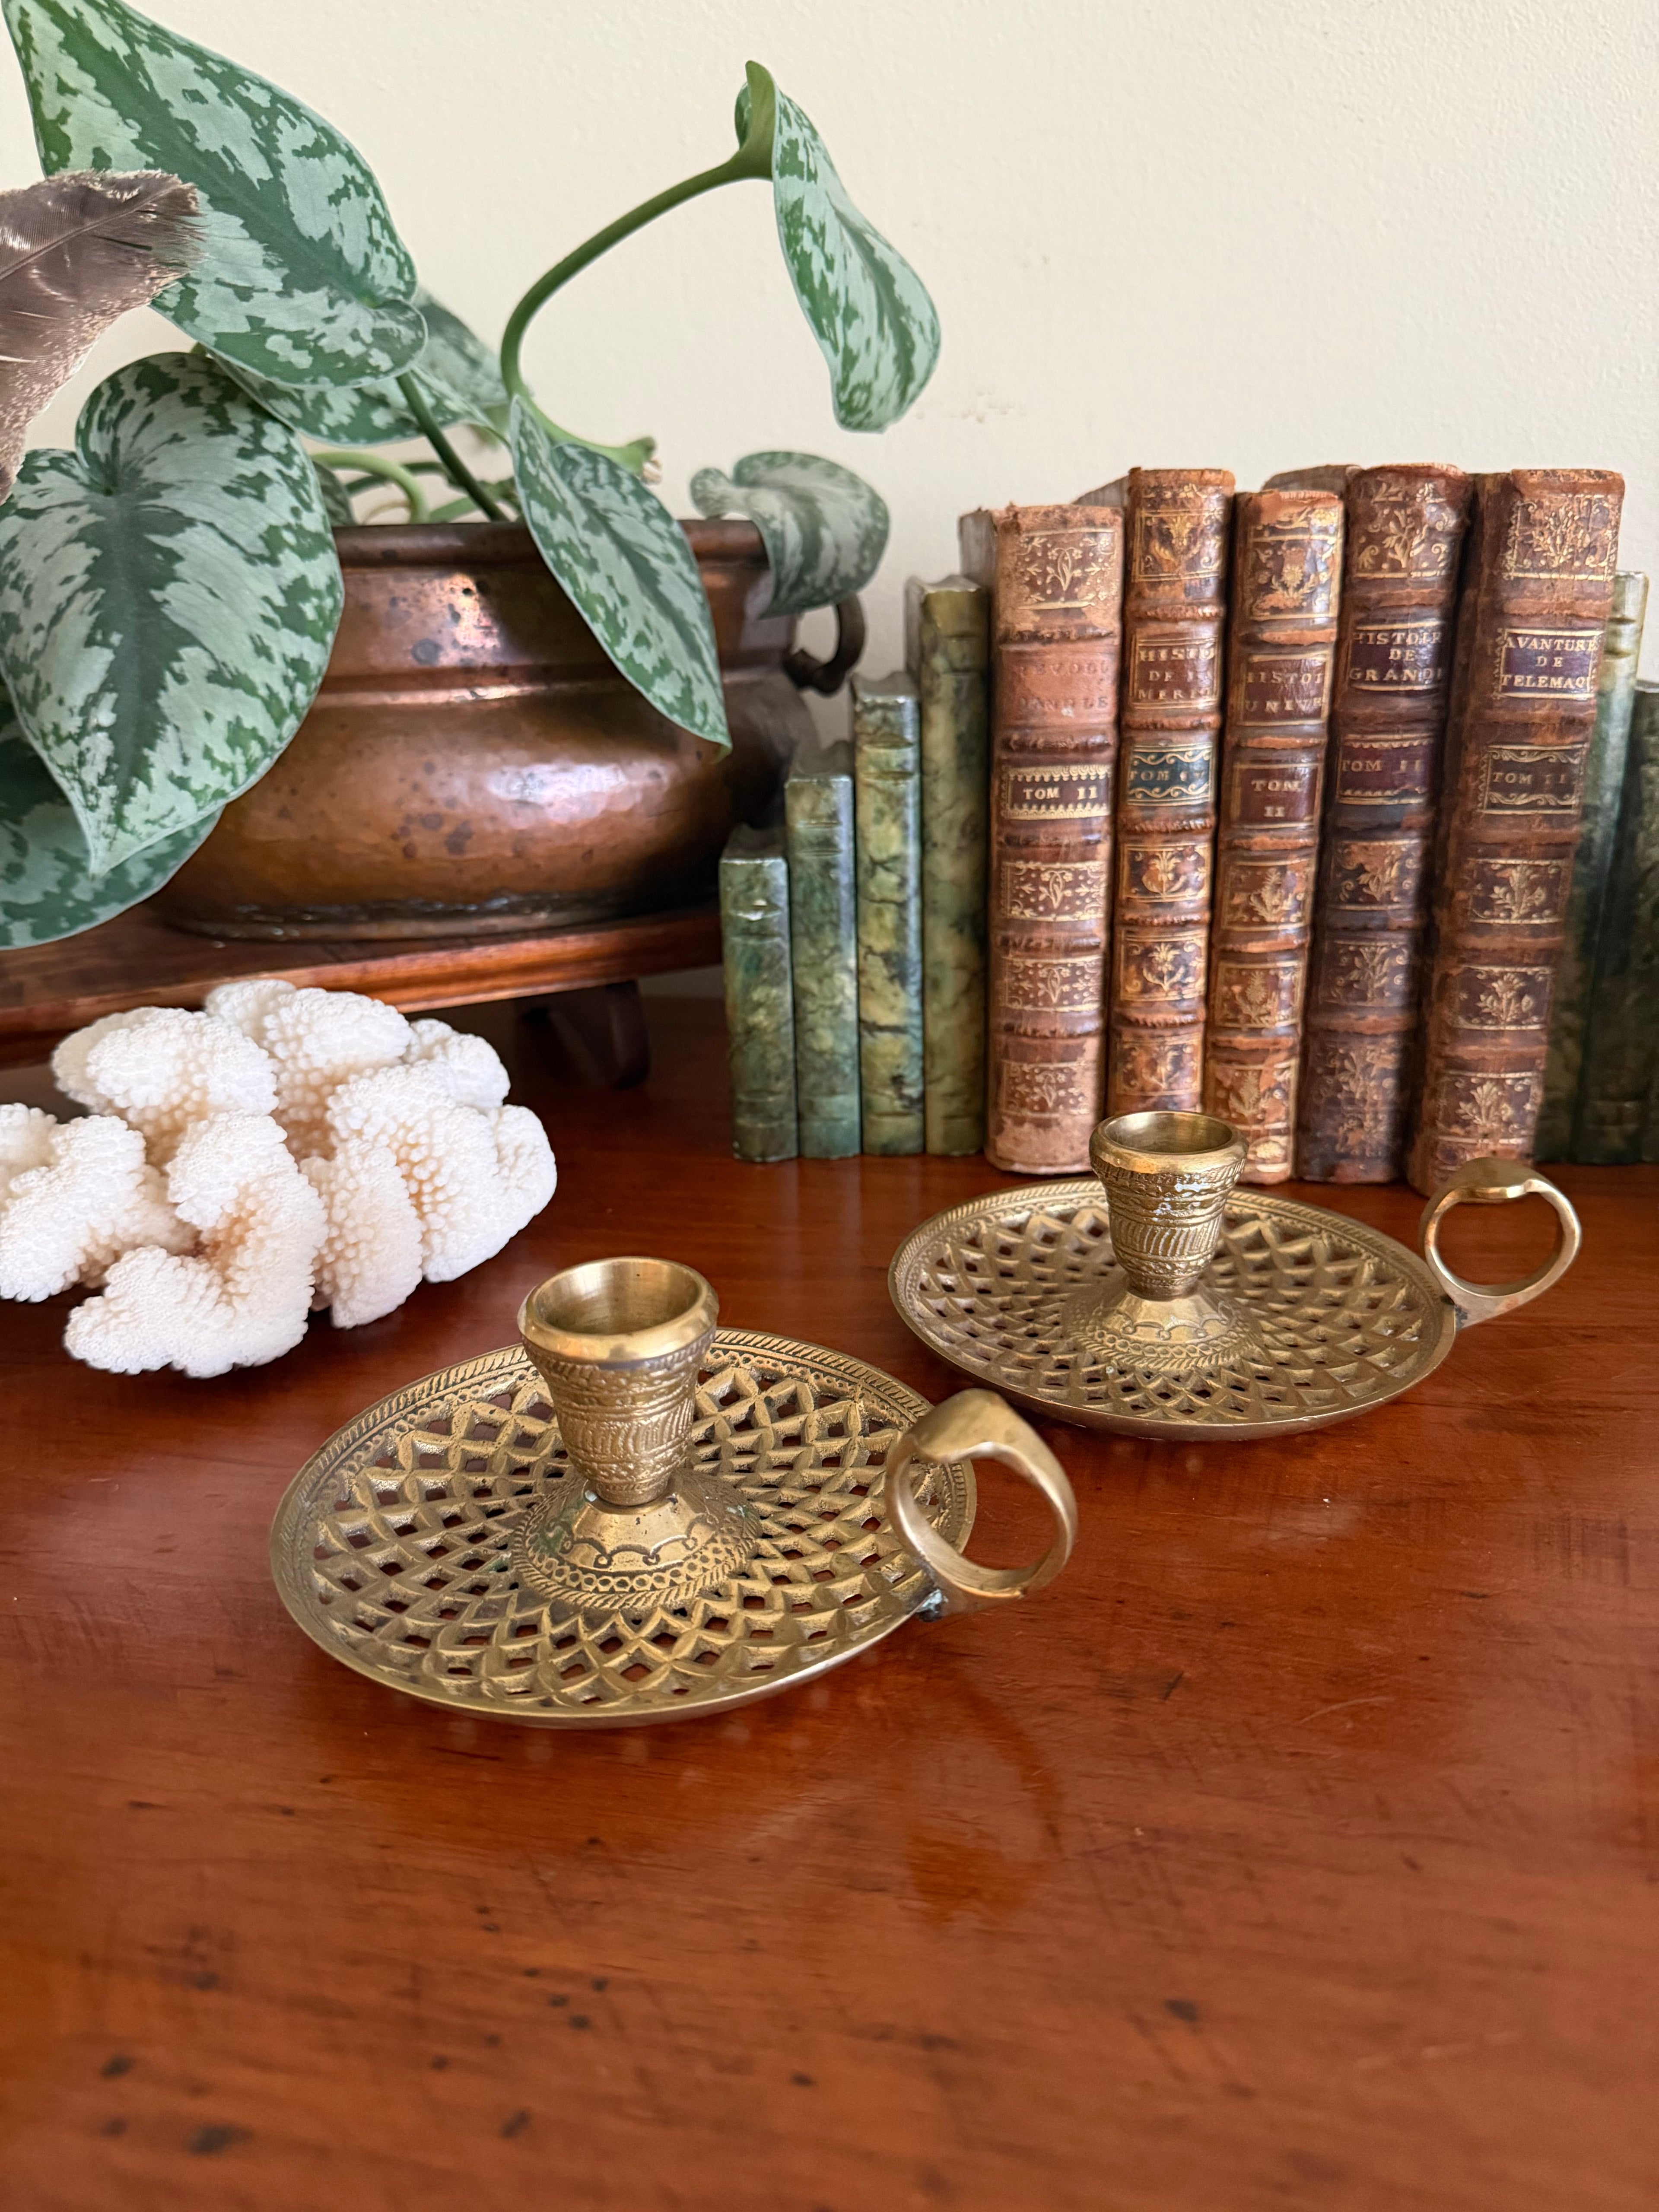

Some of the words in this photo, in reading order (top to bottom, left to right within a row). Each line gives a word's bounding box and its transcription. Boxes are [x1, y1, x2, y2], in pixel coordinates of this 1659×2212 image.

[1388, 648, 1416, 661] DE
[1535, 656, 1564, 667] DE
[1349, 668, 1443, 682] GRAND
[1341, 760, 1382, 772] TOM
[1128, 770, 1169, 781] TOM
[1493, 772, 1533, 784] TOM
[1251, 780, 1302, 792] TOM
[1023, 787, 1061, 800] TOM
[1077, 785, 1098, 800] II
[1264, 806, 1285, 817] II
